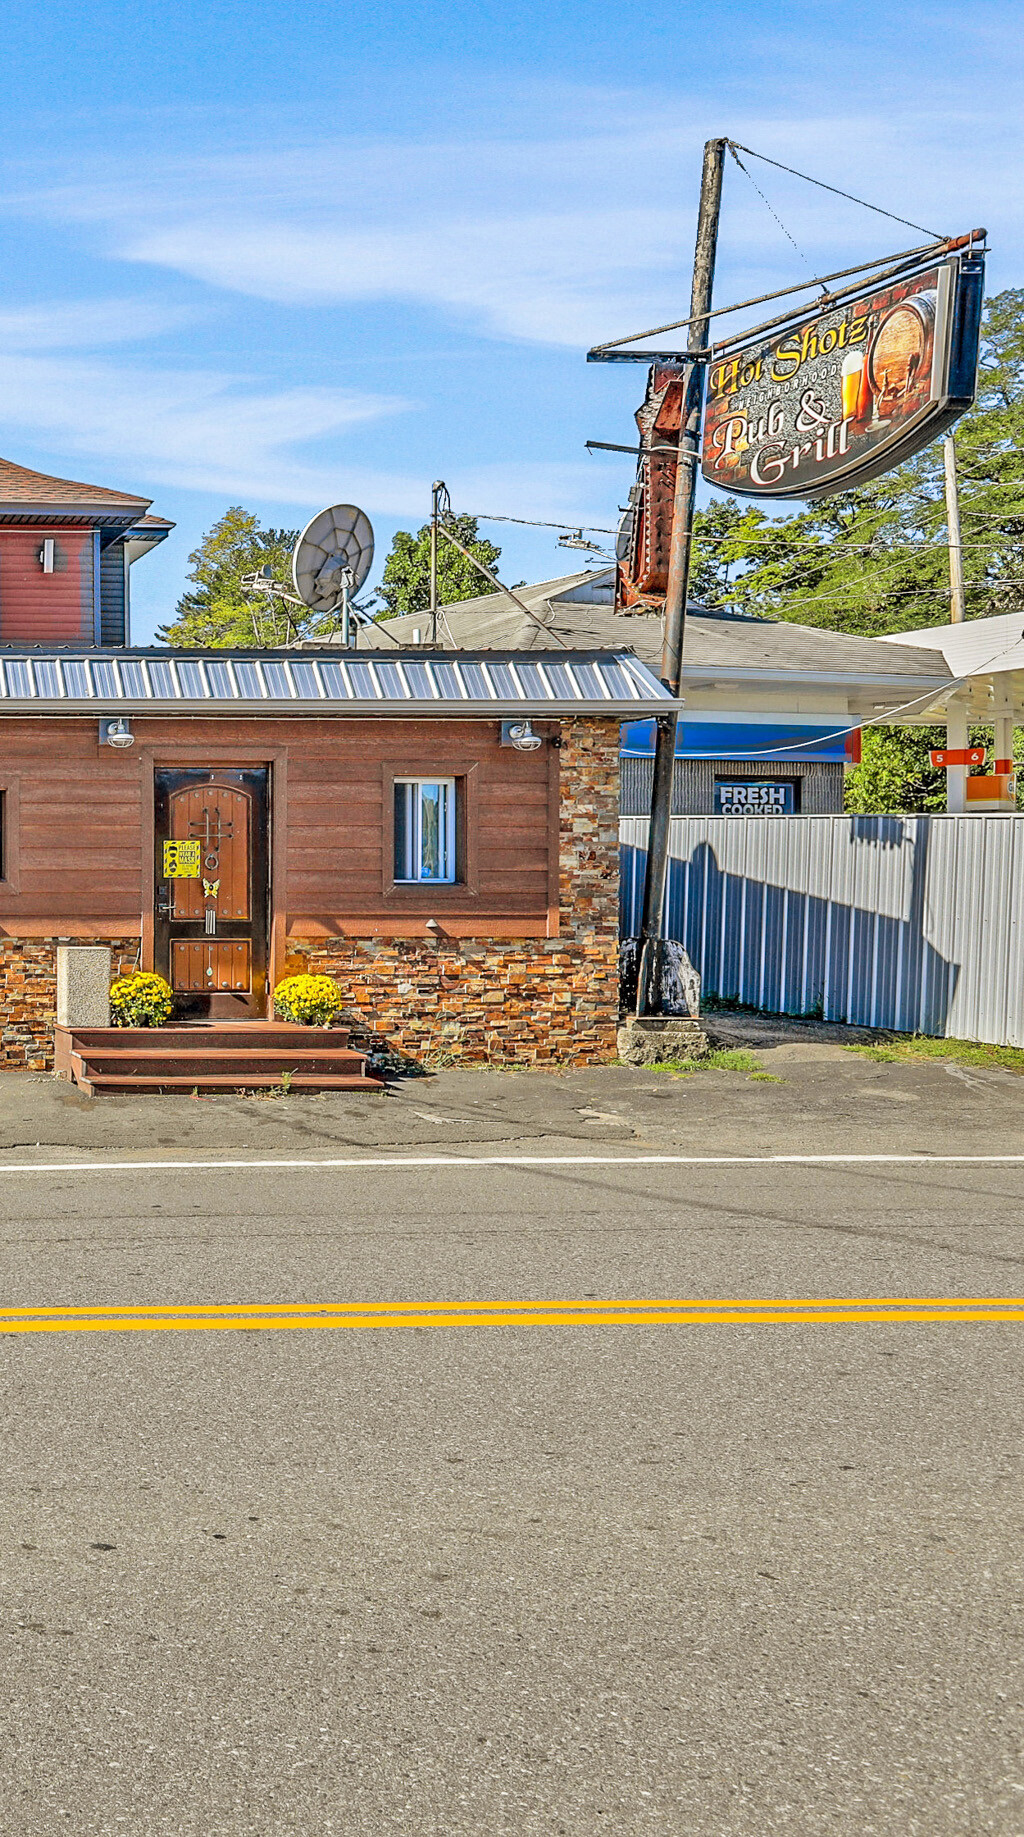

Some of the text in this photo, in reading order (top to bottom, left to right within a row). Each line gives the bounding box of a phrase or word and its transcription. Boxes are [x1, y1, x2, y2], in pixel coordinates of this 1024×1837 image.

[710, 315, 870, 399] Hot Shotz
[738, 364, 838, 410] NEIGHBORHOOD
[713, 390, 832, 469] Pub &
[750, 416, 855, 485] Grill
[936, 754, 944, 763] 5
[970, 752, 979, 761] 6
[720, 787, 785, 804] FRESH
[721, 803, 783, 815] COOKED
